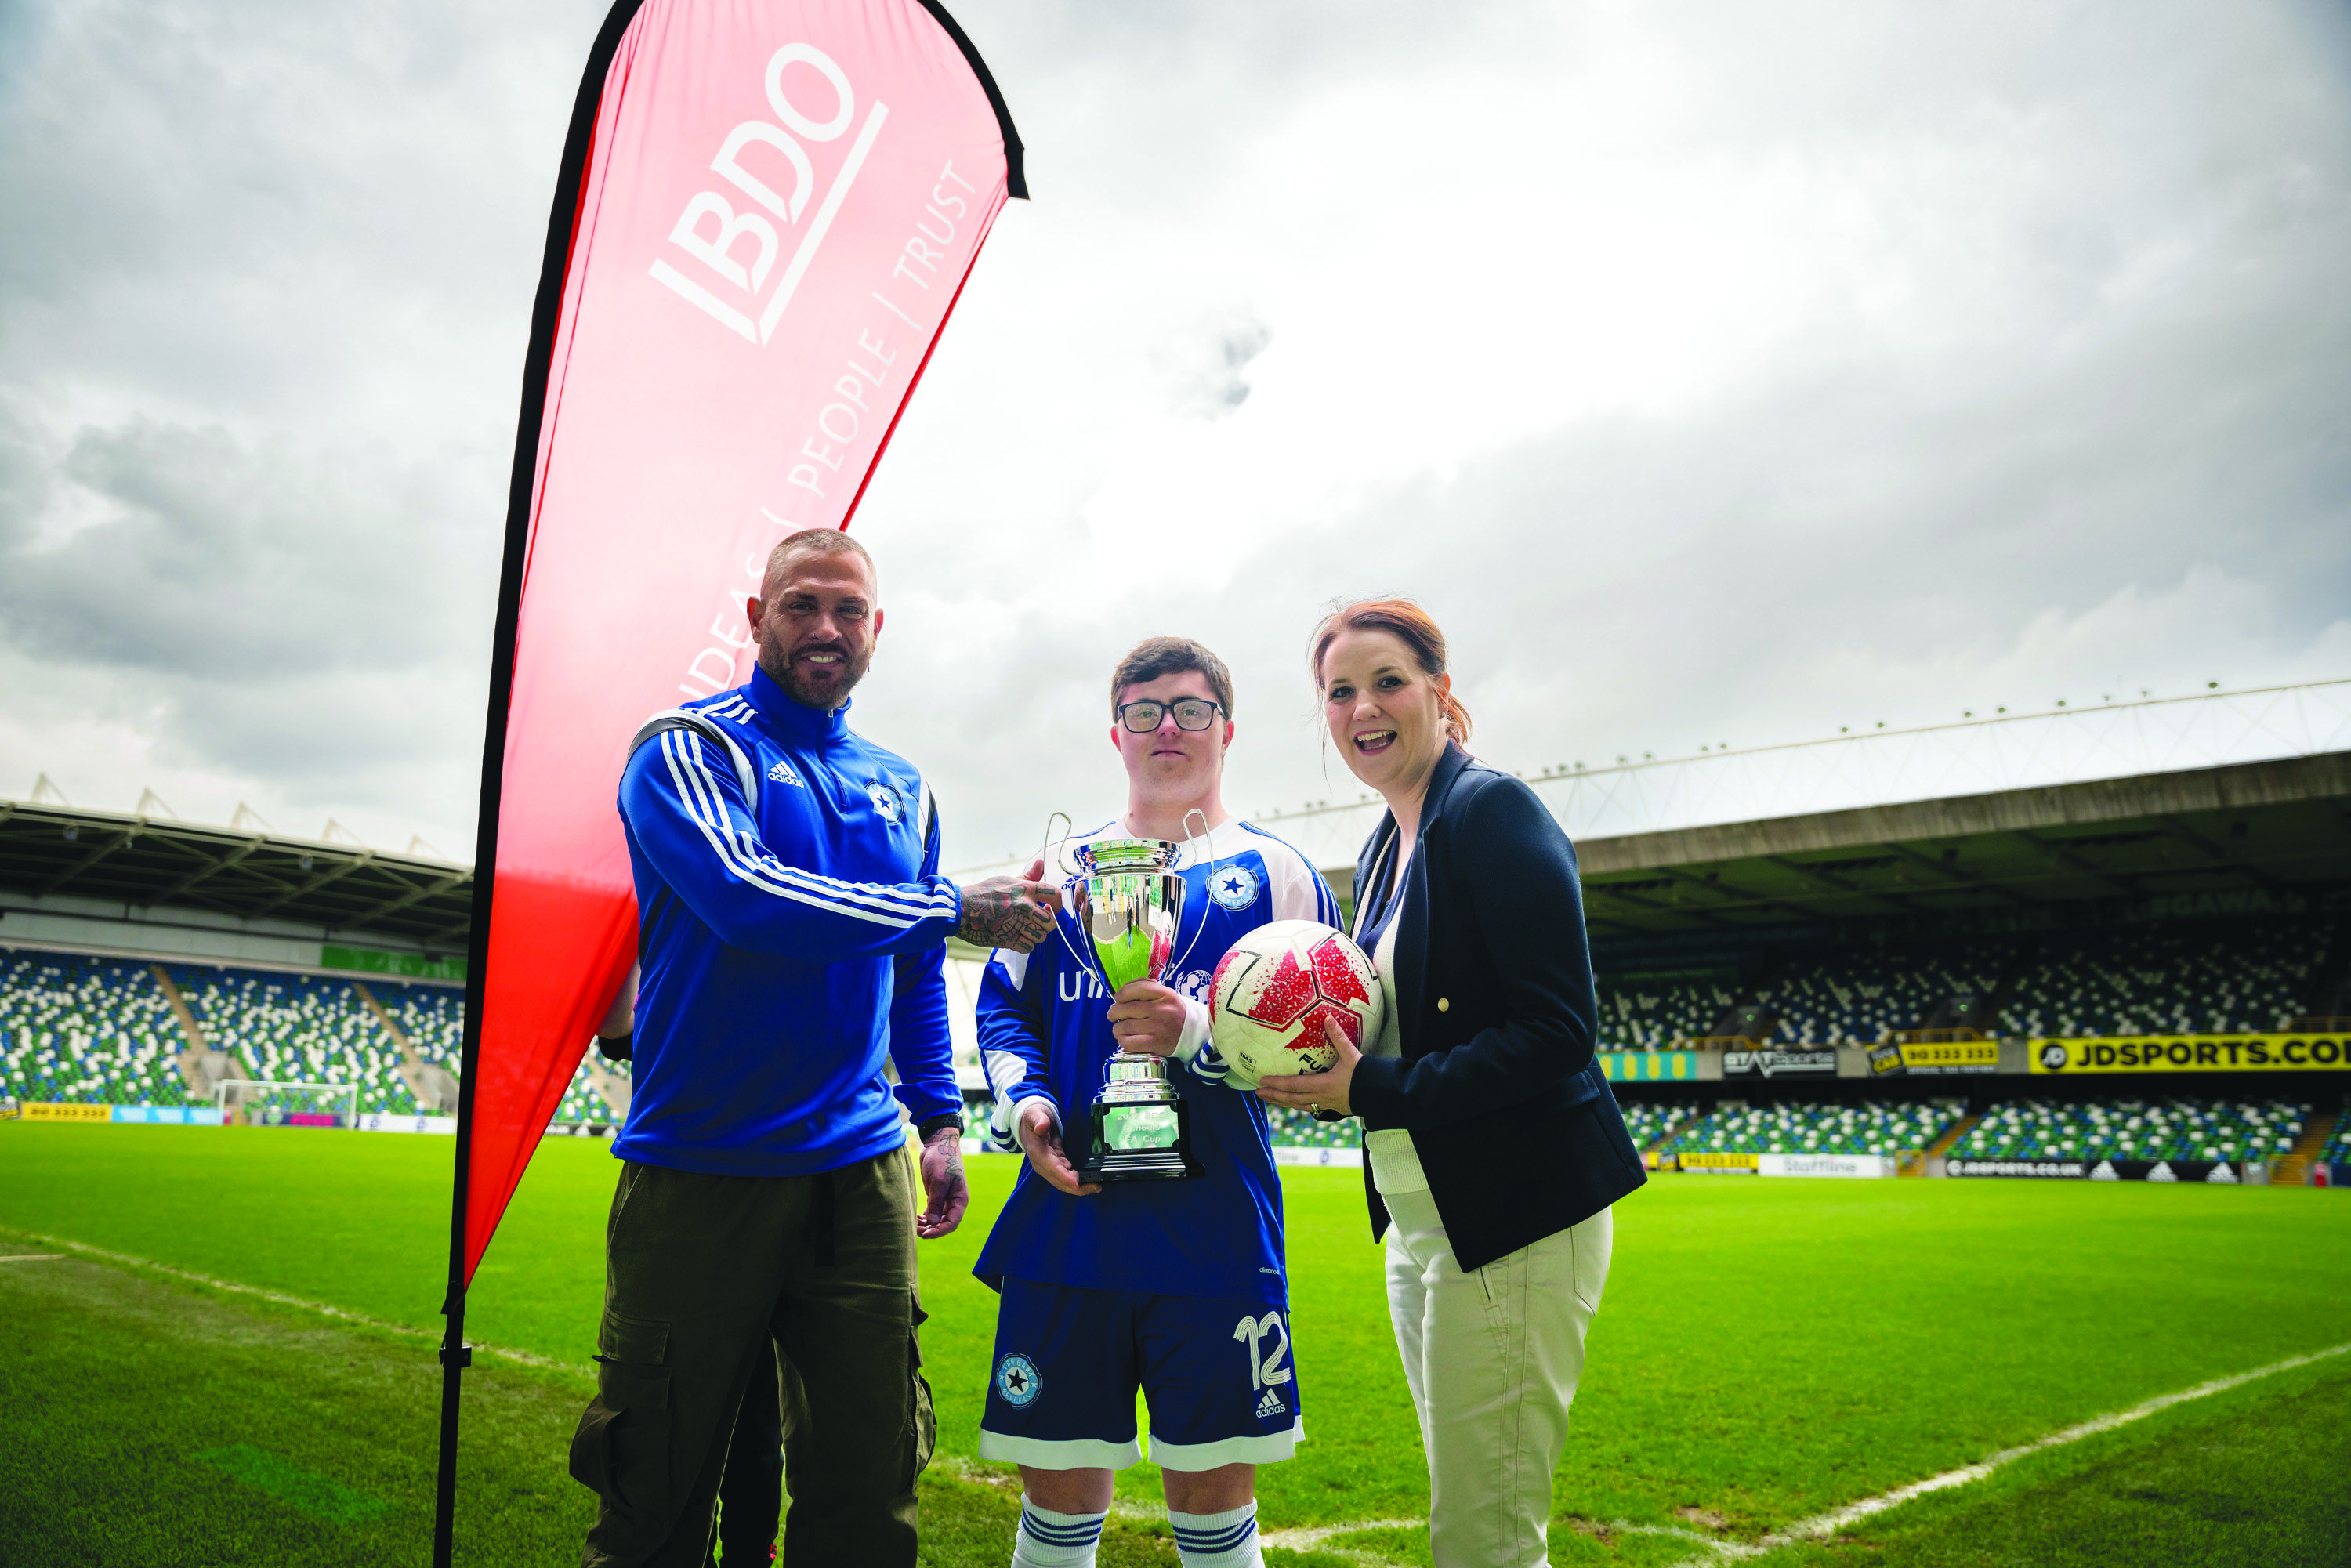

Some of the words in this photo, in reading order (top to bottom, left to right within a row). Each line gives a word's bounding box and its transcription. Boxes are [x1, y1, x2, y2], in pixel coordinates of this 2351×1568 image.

[668, 42, 855, 297] BDO
[788, 328, 897, 499] PEOPLE
[892, 158, 976, 291] TRUST
[768, 771, 805, 788] adidas
[1241, 1052, 1252, 1063] IMS
[2076, 1039, 2351, 1067] JDSPORTS.CO
[1143, 1134, 1161, 1144] Cup
[1783, 1156, 1857, 1174] Staffline
[1233, 1311, 1292, 1392] 12
[1255, 1403, 1286, 1418] adidas
